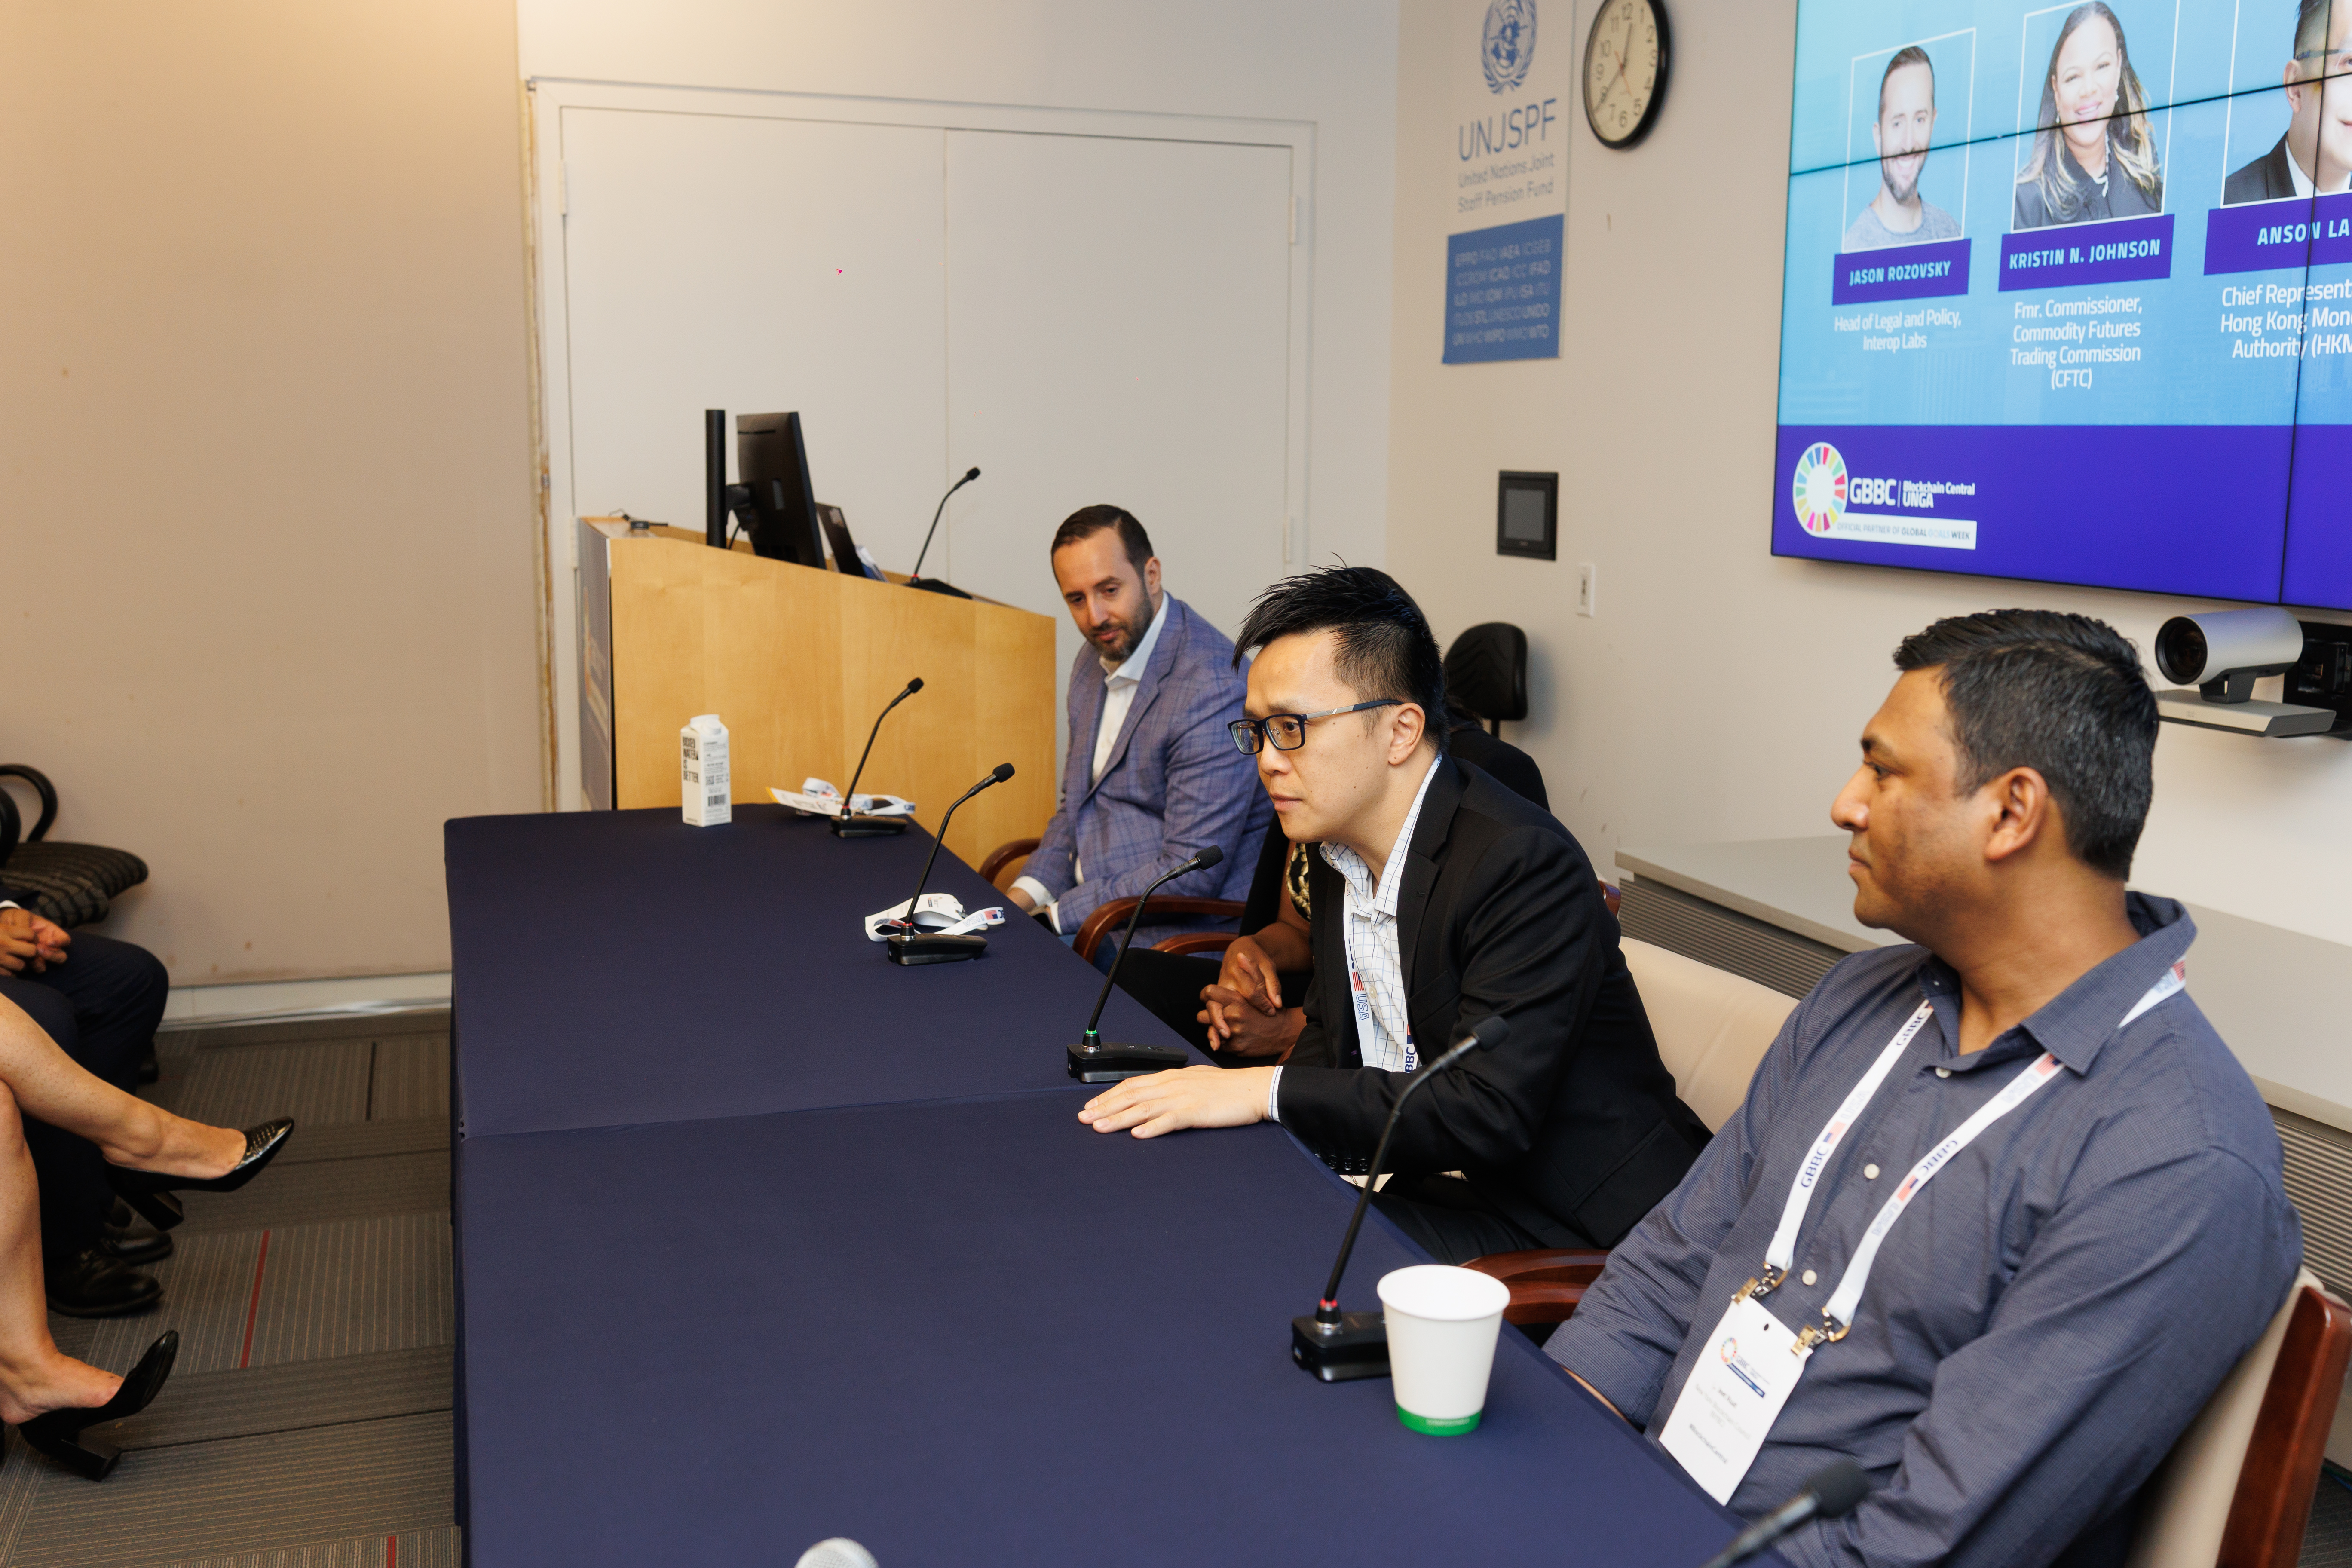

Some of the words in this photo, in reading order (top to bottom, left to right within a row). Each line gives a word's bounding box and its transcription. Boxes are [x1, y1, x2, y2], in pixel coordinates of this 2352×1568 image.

[1622, 2, 1633, 21] 12
[1646, 25, 1655, 43] 2
[1601, 39, 1611, 58] 10
[1649, 49, 1657, 67] 3
[1619, 110, 1627, 128] 6
[1634, 98, 1642, 116] 5
[1459, 98, 1557, 161] UNJSPF
[1458, 166, 1488, 188] United
[1490, 161, 1527, 180] Nations
[1528, 153, 1554, 171] Joint
[1458, 192, 1483, 213] Staff
[1485, 187, 1525, 207] Pension
[1527, 176, 1554, 198] Fund
[2257, 221, 2321, 245] ANSON
[2328, 218, 2350, 238] LA
[2009, 248, 2064, 270] KRISTIN
[2069, 247, 2084, 264] N.
[2089, 239, 2160, 263] JOHNSON
[1849, 267, 1884, 287] JASON
[1887, 260, 1951, 282] ROZOVSKY
[2222, 284, 2263, 307] Chief
[2266, 279, 2352, 308] Represent
[2015, 302, 2042, 319] Fmr.
[2046, 295, 2142, 317] Commissioner,
[1834, 314, 1860, 331] Head
[1862, 313, 1874, 330] of
[1875, 311, 1902, 333] Legal
[1904, 309, 1925, 327] and
[1926, 308, 1961, 328] Policy,
[2013, 322, 2086, 344] Commodity
[2089, 321, 2141, 338] Futures
[2221, 313, 2263, 337] Hong
[2266, 311, 2309, 334] Kong
[2312, 307, 2352, 328] Mon
[1863, 335, 1900, 353] Interop
[1902, 332, 1927, 349] Labs
[2232, 337, 2308, 360] Authority
[2010, 347, 2057, 369] Trading
[2060, 343, 2141, 364] Commission
[2051, 368, 2092, 390] (CFTC)
[1850, 477, 1897, 506] GBBC
[1902, 492, 1934, 508] UNGA
[1903, 480, 1945, 494] Blockchain
[1945, 481, 1975, 496] Central
[1838, 522, 1861, 531] OFFICIAL
[1863, 524, 1891, 534] PARTNER
[1902, 527, 1926, 536] GLOBAL
[1928, 529, 1950, 538] GOALS
[1951, 531, 1970, 540] WEEK
[683, 736, 695, 748] BOXED
[963, 913, 984, 927] USA
[1356, 994, 1369, 1021] USA
[1896, 1012, 1928, 1046] GBBC
[1405, 1047, 1416, 1072] BBC
[1801, 1146, 1828, 1188] GBBC
